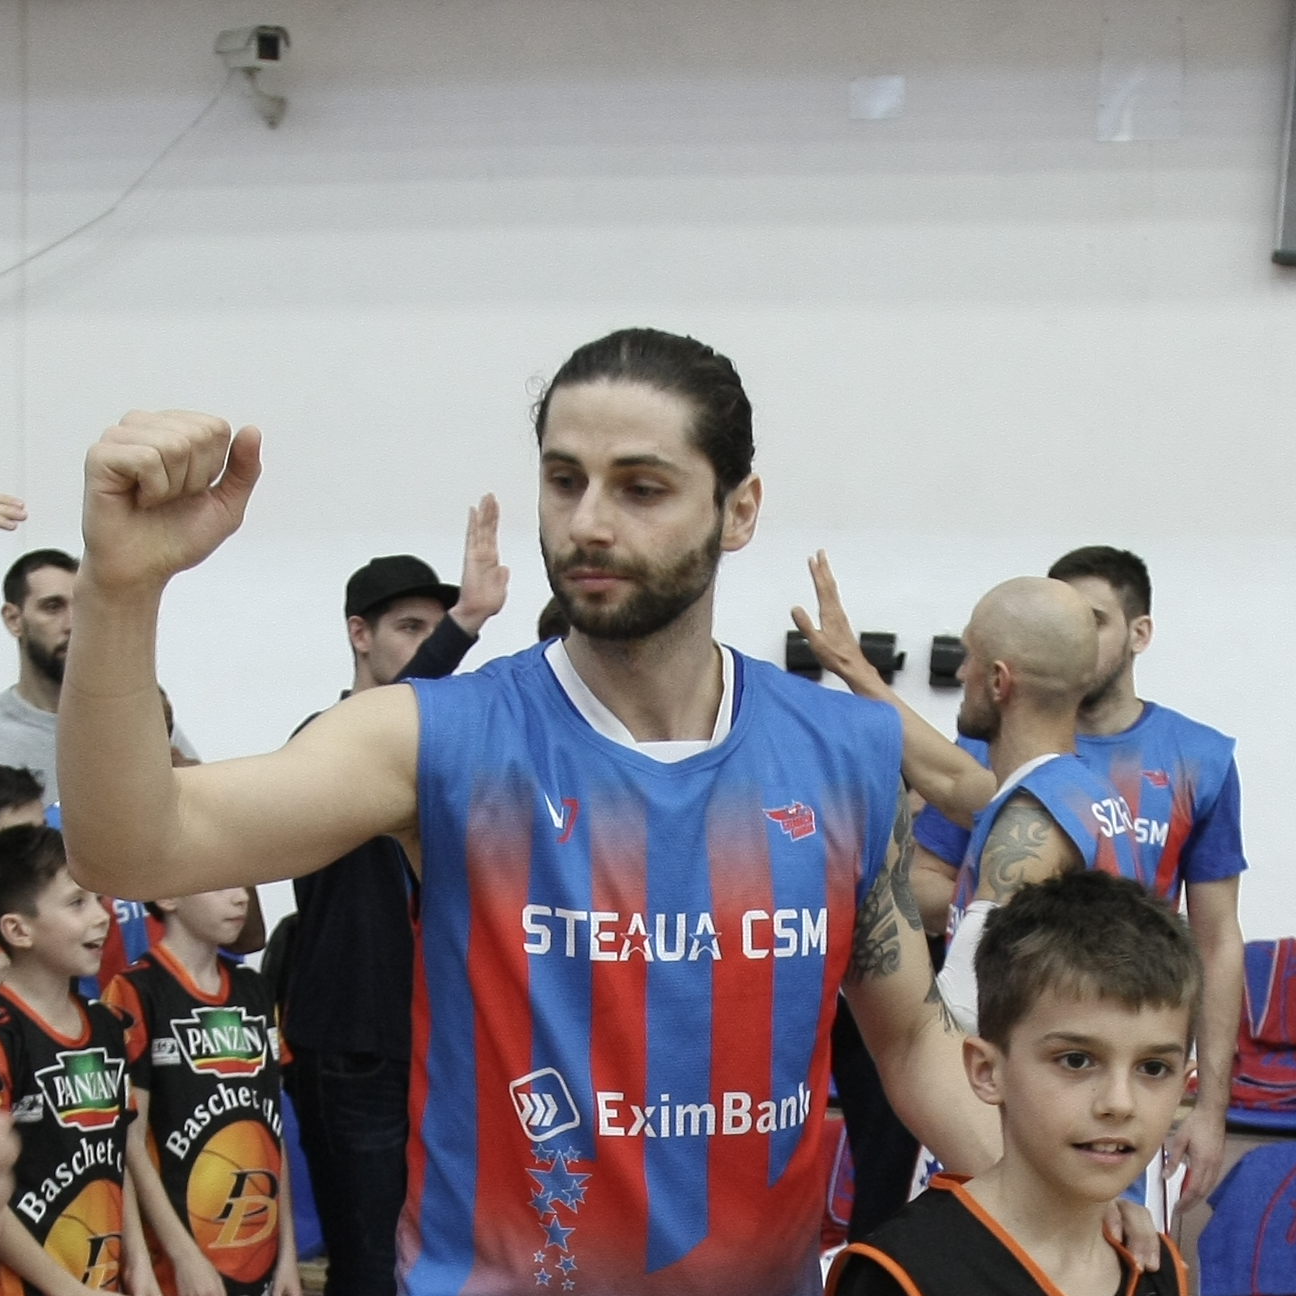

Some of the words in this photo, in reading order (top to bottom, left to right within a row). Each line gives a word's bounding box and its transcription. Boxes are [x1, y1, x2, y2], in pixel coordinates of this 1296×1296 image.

[1132, 817, 1170, 848] SM
[521, 904, 723, 962] STEAUA
[741, 906, 829, 960] CSM
[597, 1086, 812, 1138] EximBank
[16, 1137, 115, 1225] Baschet
